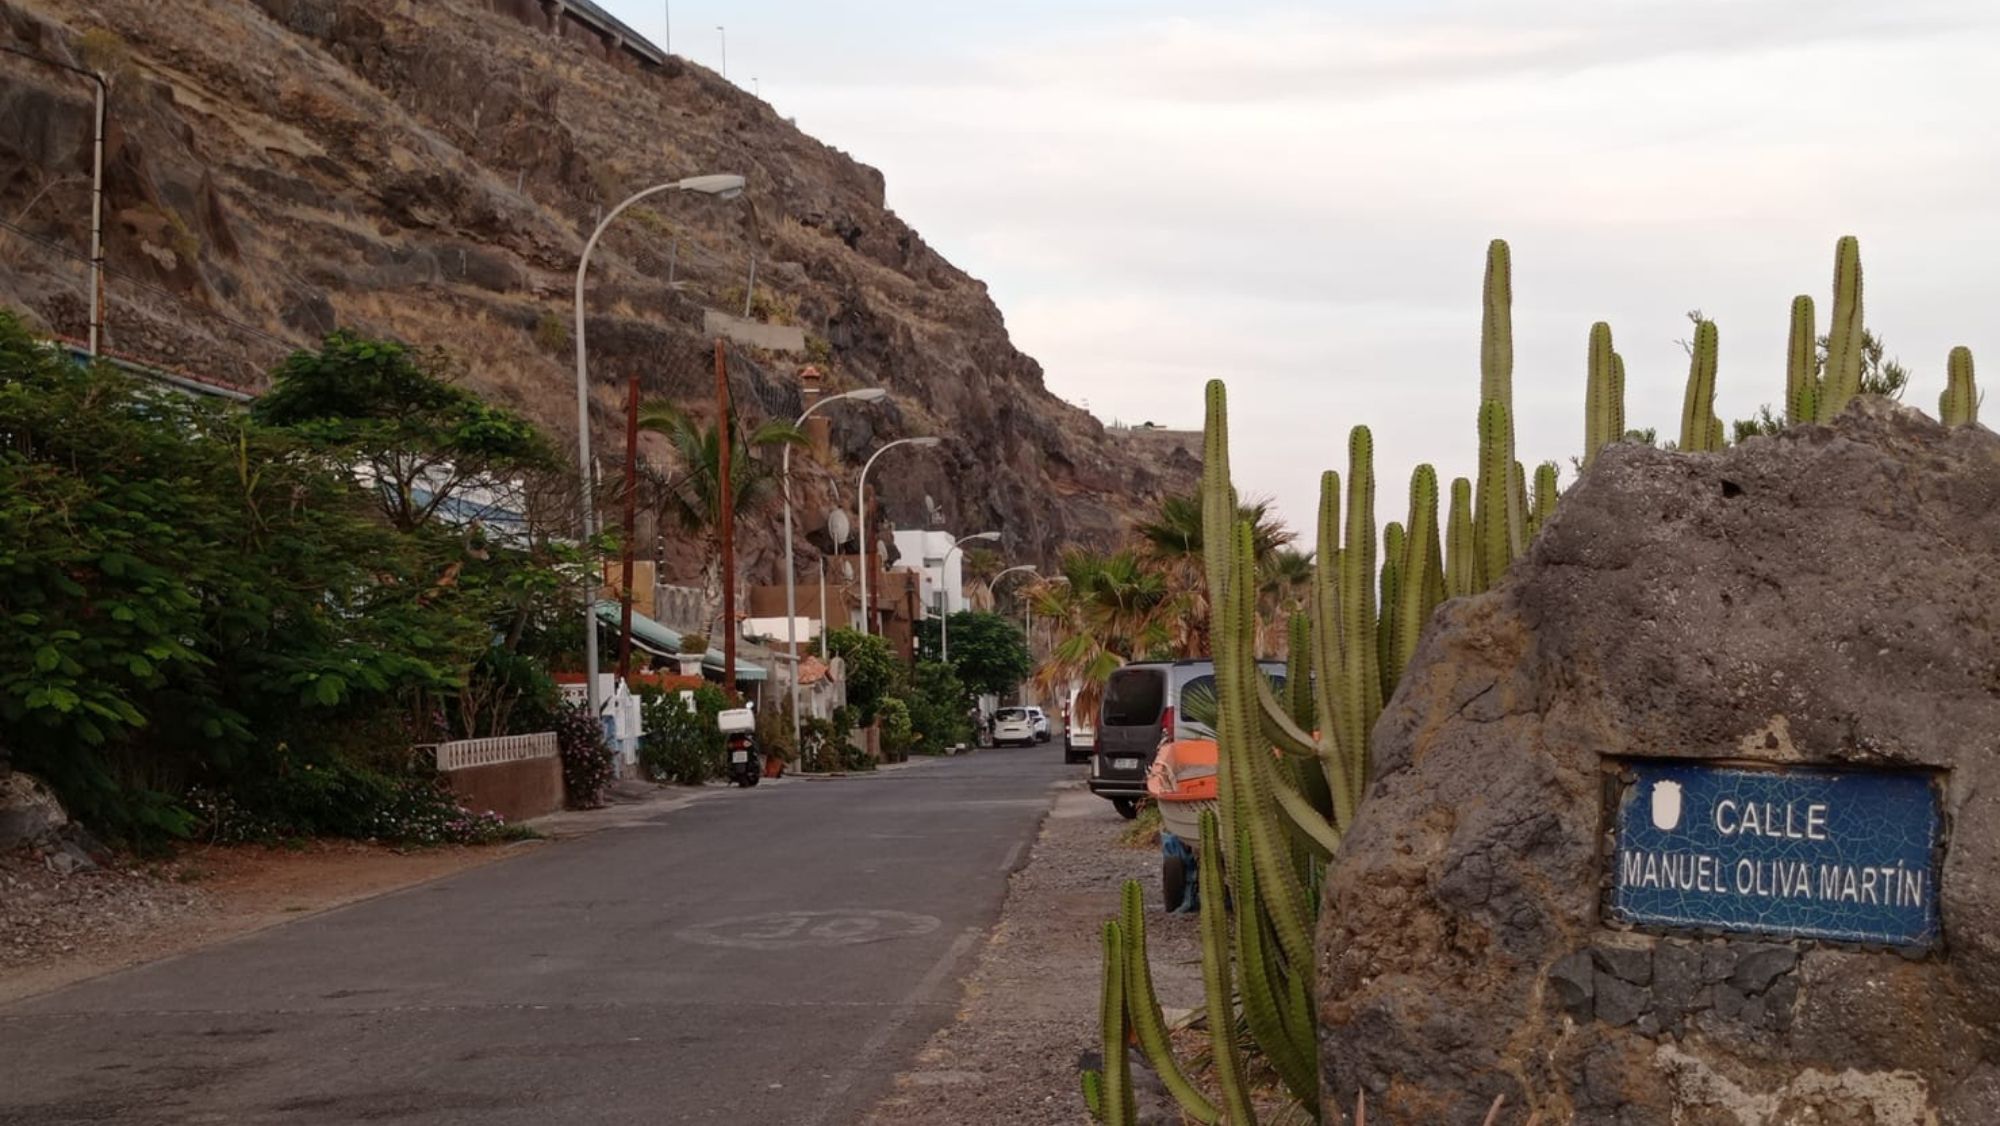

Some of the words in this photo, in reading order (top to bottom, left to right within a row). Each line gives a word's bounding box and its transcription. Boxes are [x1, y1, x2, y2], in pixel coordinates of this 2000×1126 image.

[1715, 800, 1827, 840] CALLE
[1622, 851, 1727, 893] MANUEL
[1735, 858, 1812, 899] OLIVA
[1819, 859, 1923, 907] MARTÍN
